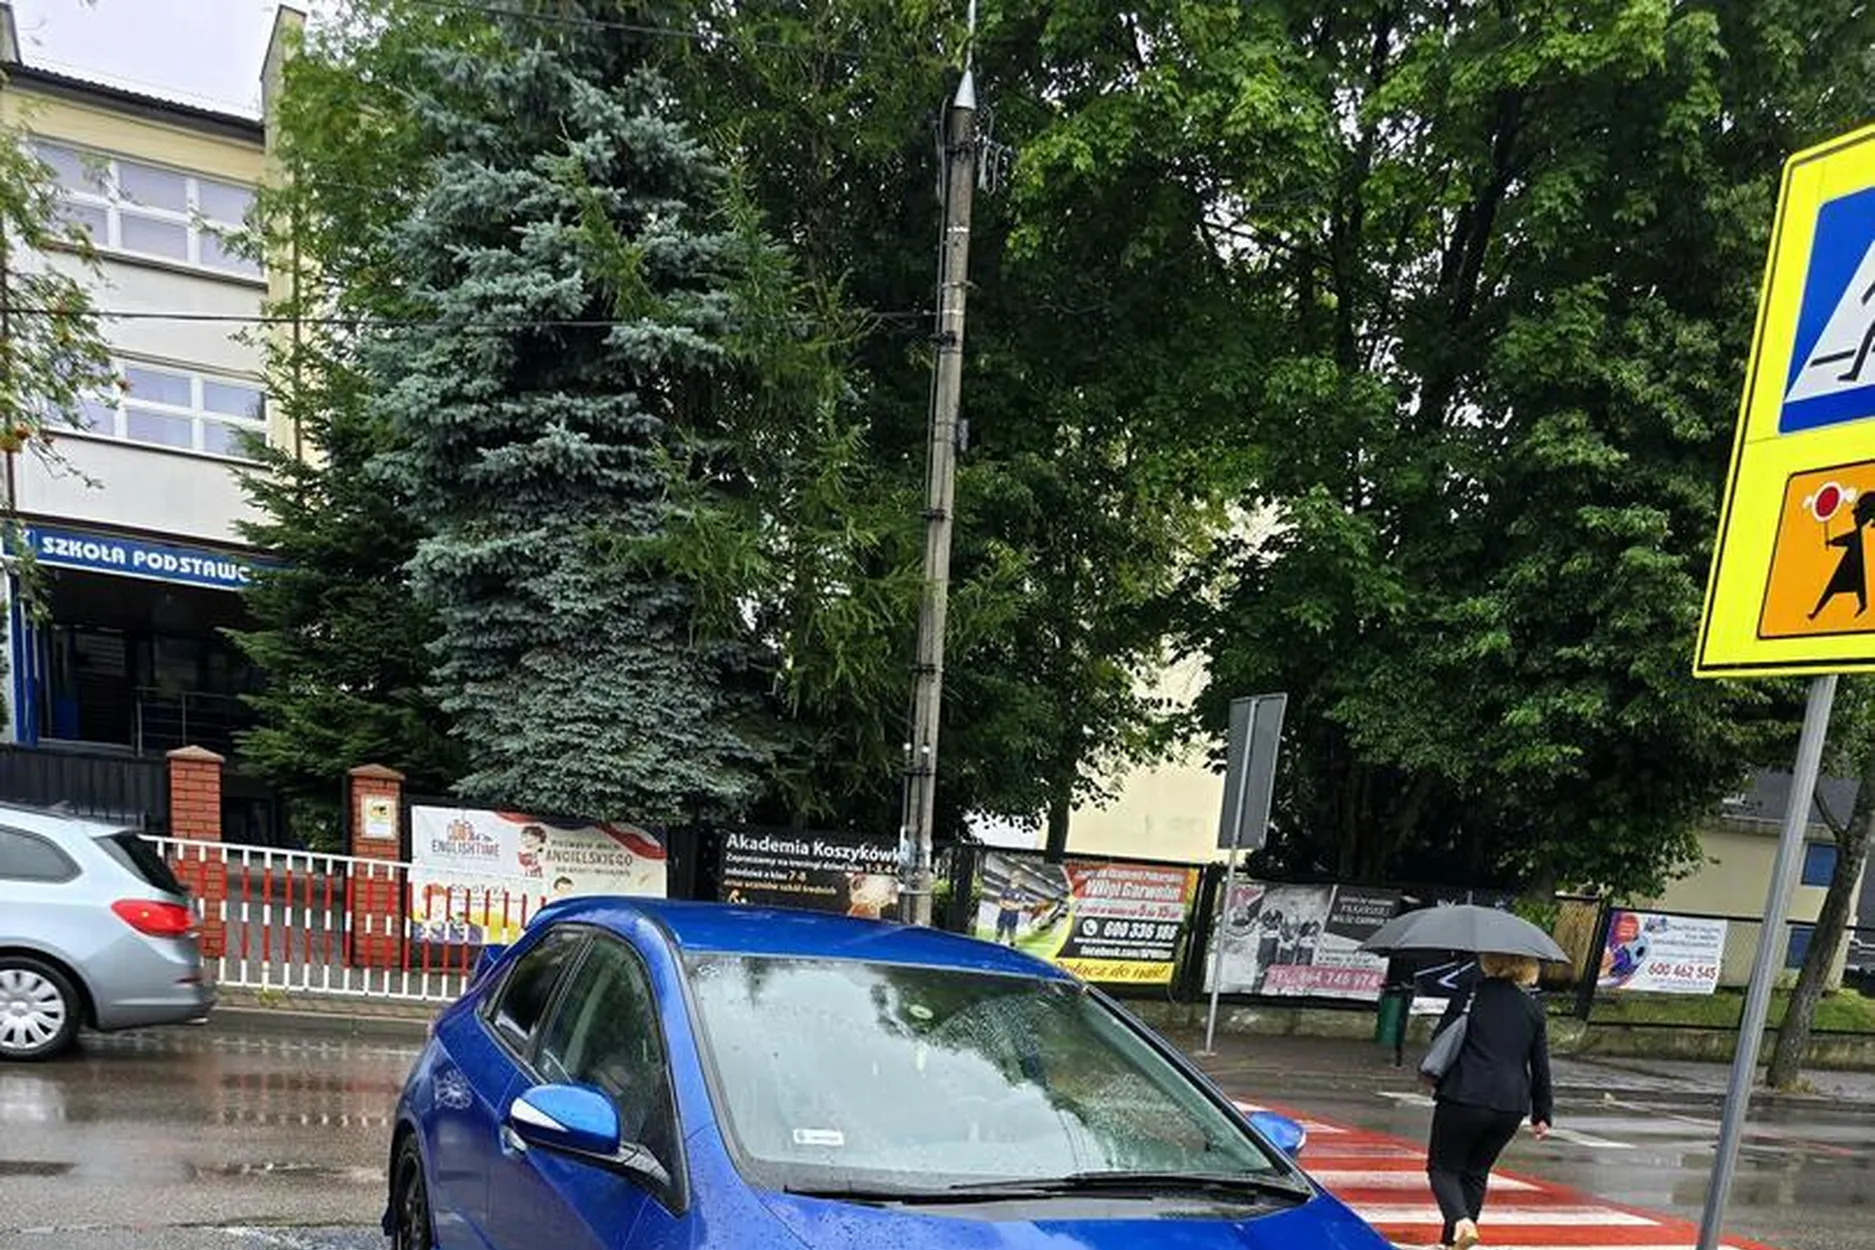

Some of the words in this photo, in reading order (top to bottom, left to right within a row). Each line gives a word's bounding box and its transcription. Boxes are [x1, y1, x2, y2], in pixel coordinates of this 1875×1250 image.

[42, 535, 126, 565] SZKOŁA
[133, 550, 251, 582] PODSTAWO
[726, 832, 809, 855] Akademia
[813, 841, 901, 862] Koszykówk
